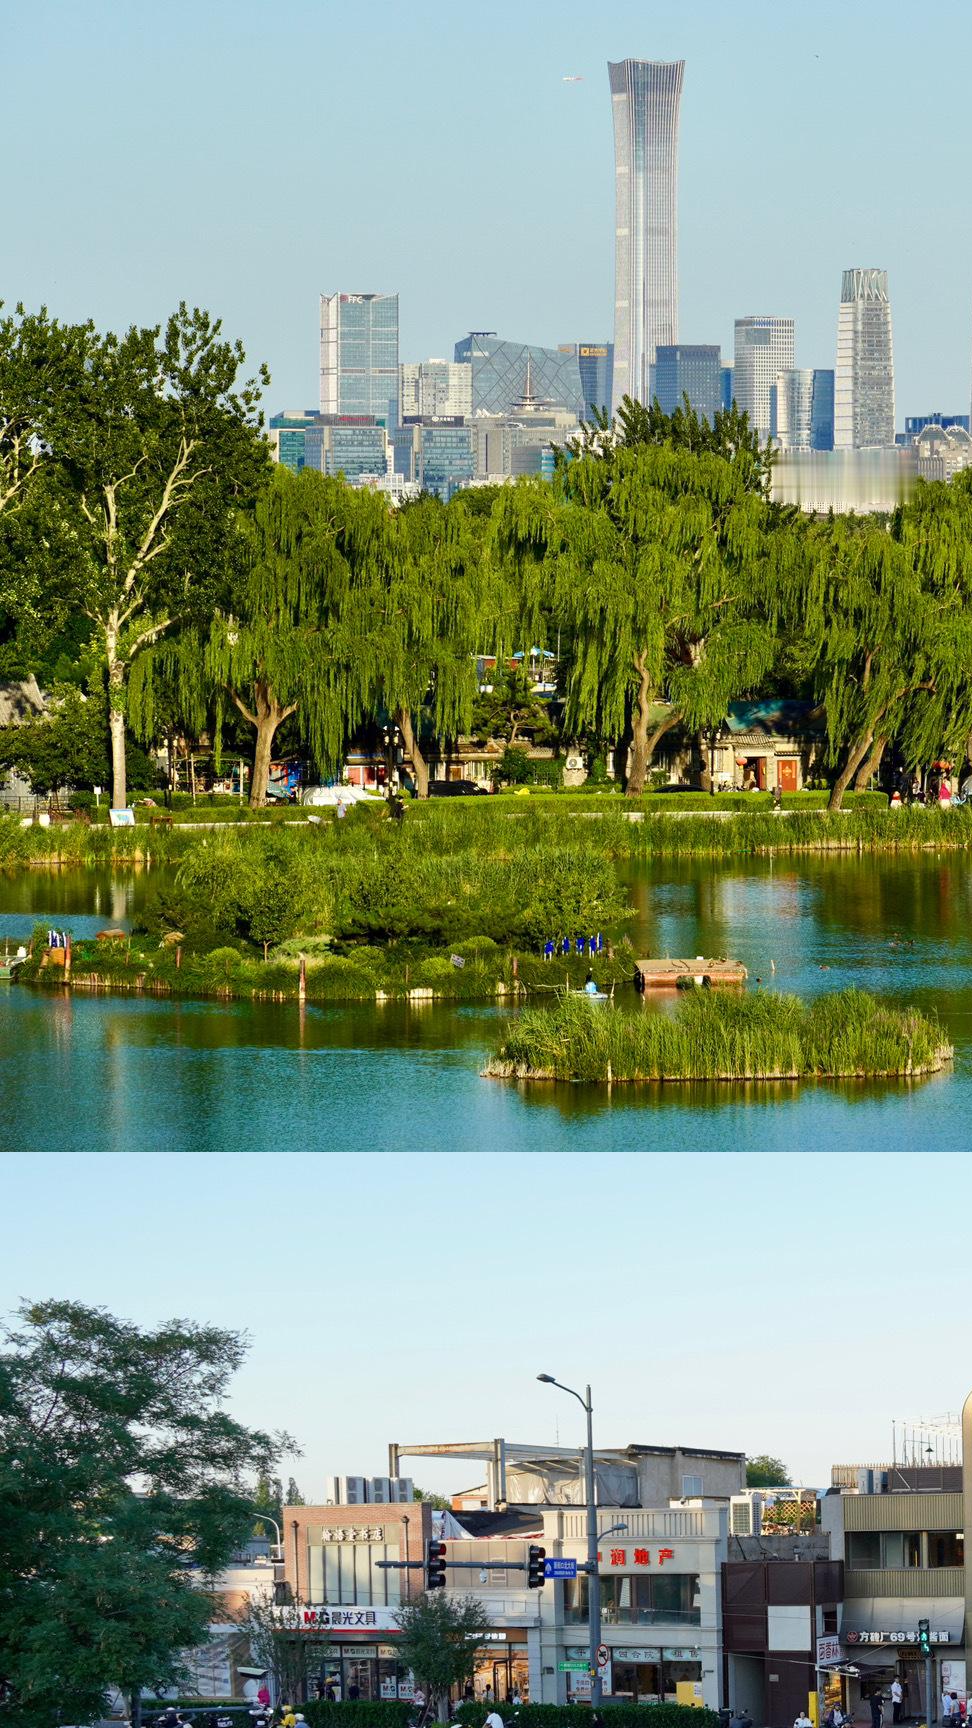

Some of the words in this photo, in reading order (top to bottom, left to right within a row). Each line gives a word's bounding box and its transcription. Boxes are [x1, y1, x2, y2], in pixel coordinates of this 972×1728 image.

[597, 1548, 674, 1566] 润地产
[331, 1611, 376, 1625] 晨光文具
[860, 1631, 949, 1642] 方砖厂69号酱面
